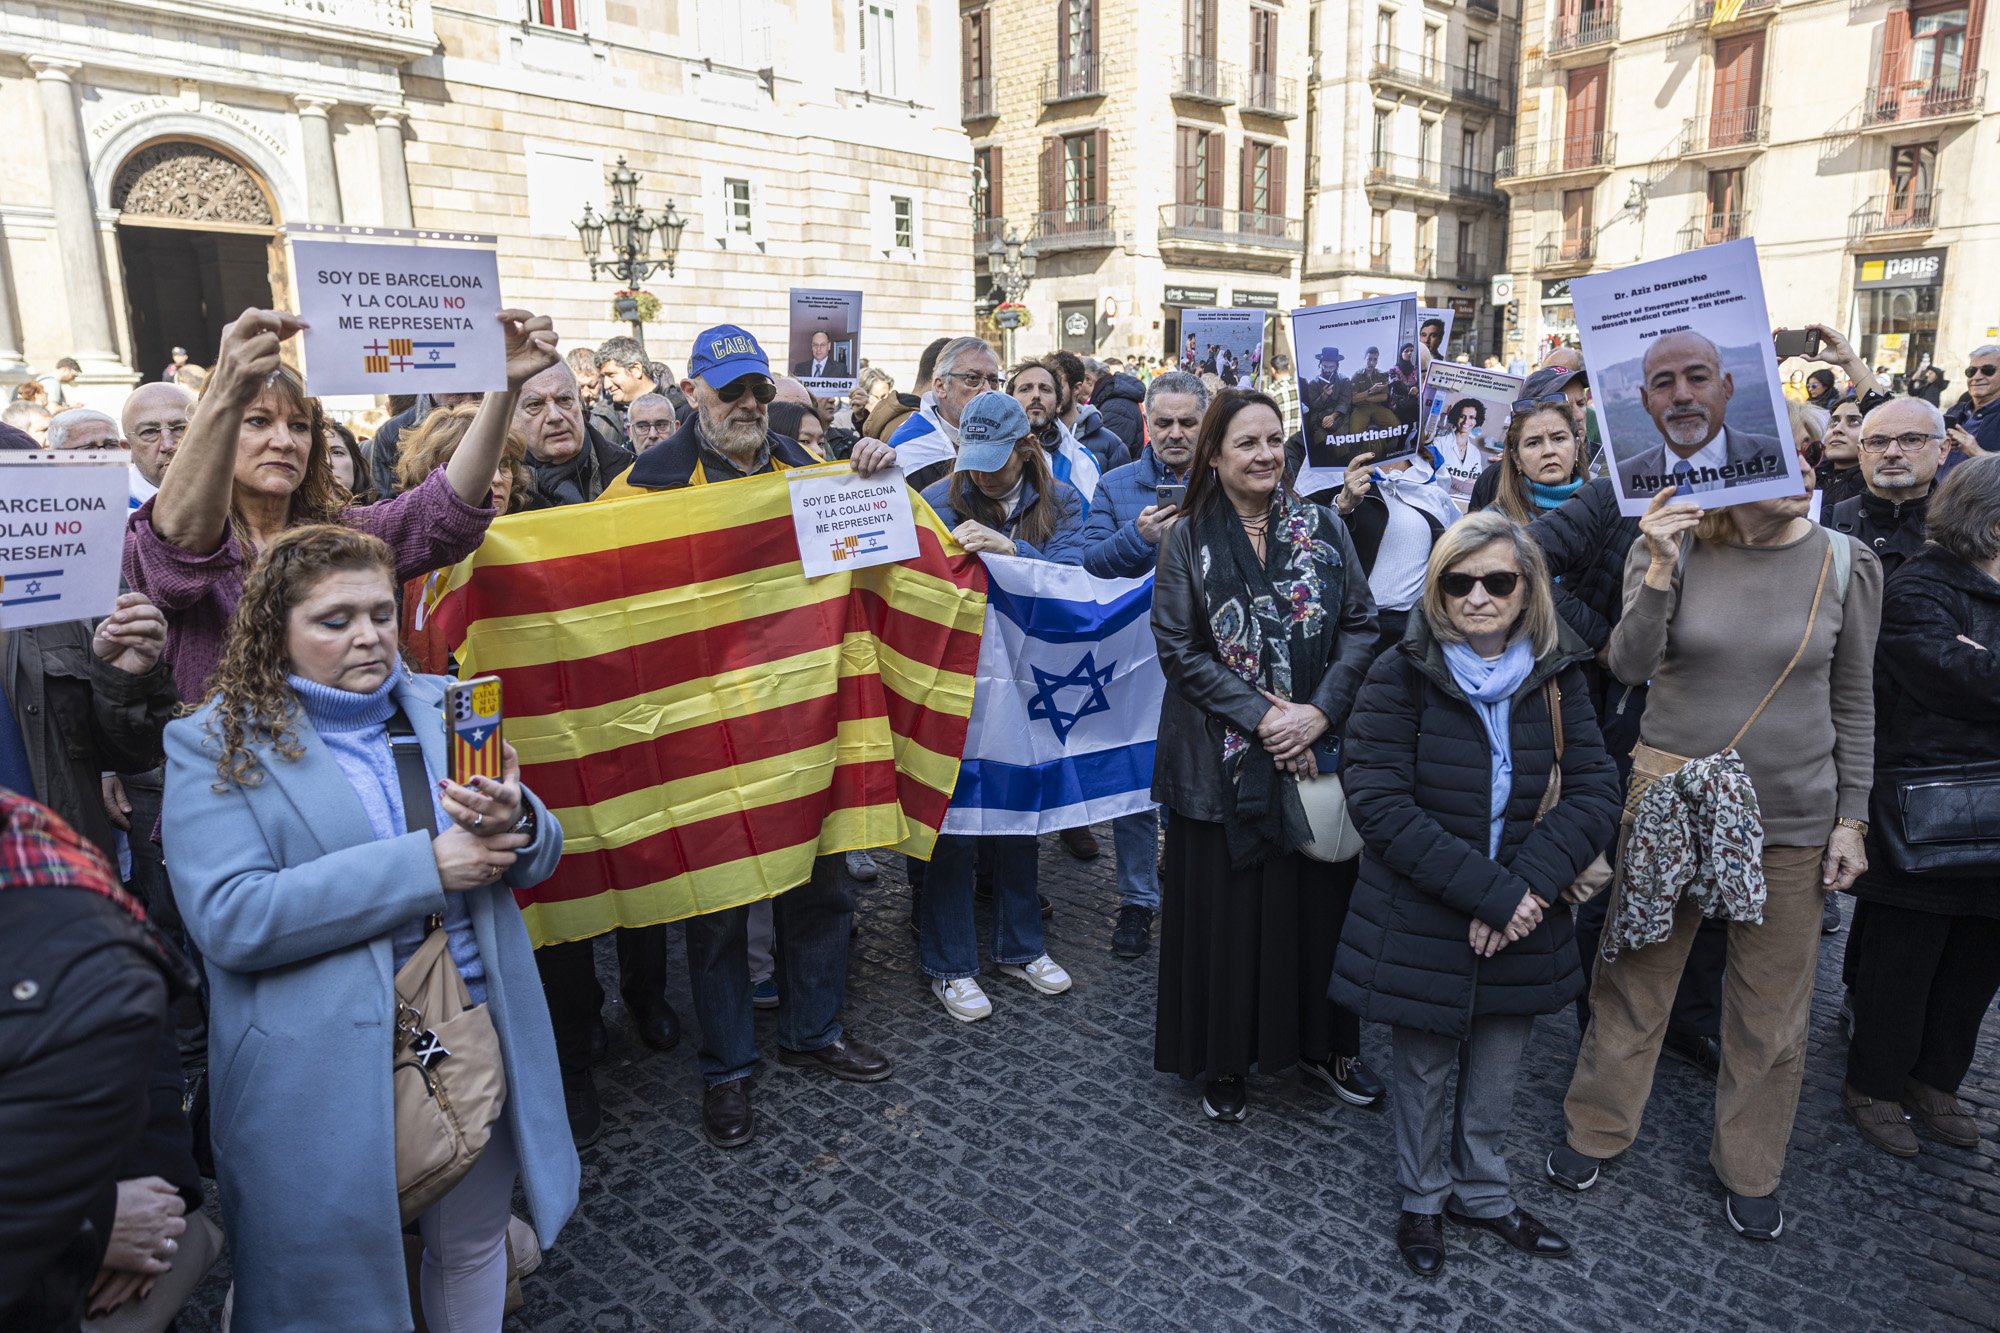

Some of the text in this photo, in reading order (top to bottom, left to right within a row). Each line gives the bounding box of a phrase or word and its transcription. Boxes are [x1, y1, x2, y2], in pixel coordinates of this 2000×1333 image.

[93, 110, 128, 139] PALAU
[132, 101, 148, 114] DE
[153, 98, 169, 109] LA
[1885, 256, 1940, 279] pans
[318, 271, 483, 289] SOY DE BARCELONA
[1614, 272, 1708, 301] Dr. Aziz Darawshe
[341, 294, 466, 309] Y LA COLAU NO
[1601, 288, 1730, 322] Director of Emergency Medicine
[339, 316, 474, 330] ME REPRESENTA
[1591, 318, 1628, 331] Hadassah
[1630, 312, 1660, 323] Medical
[1662, 306, 1690, 317] Center
[1698, 301, 1712, 310] Ein
[1714, 295, 1746, 307] Kerem.
[1639, 324, 1693, 340] Arab Muslim.
[970, 416, 1001, 429] FRANCISCO
[1326, 424, 1409, 446] Apartheid?
[1632, 454, 1780, 492] Apartheid?
[802, 485, 896, 508] SOY DE BARCELONA
[816, 500, 887, 519] Y LA COLAU NO
[54, 521, 82, 535] NO
[816, 513, 893, 534] ME REPRESENTA
